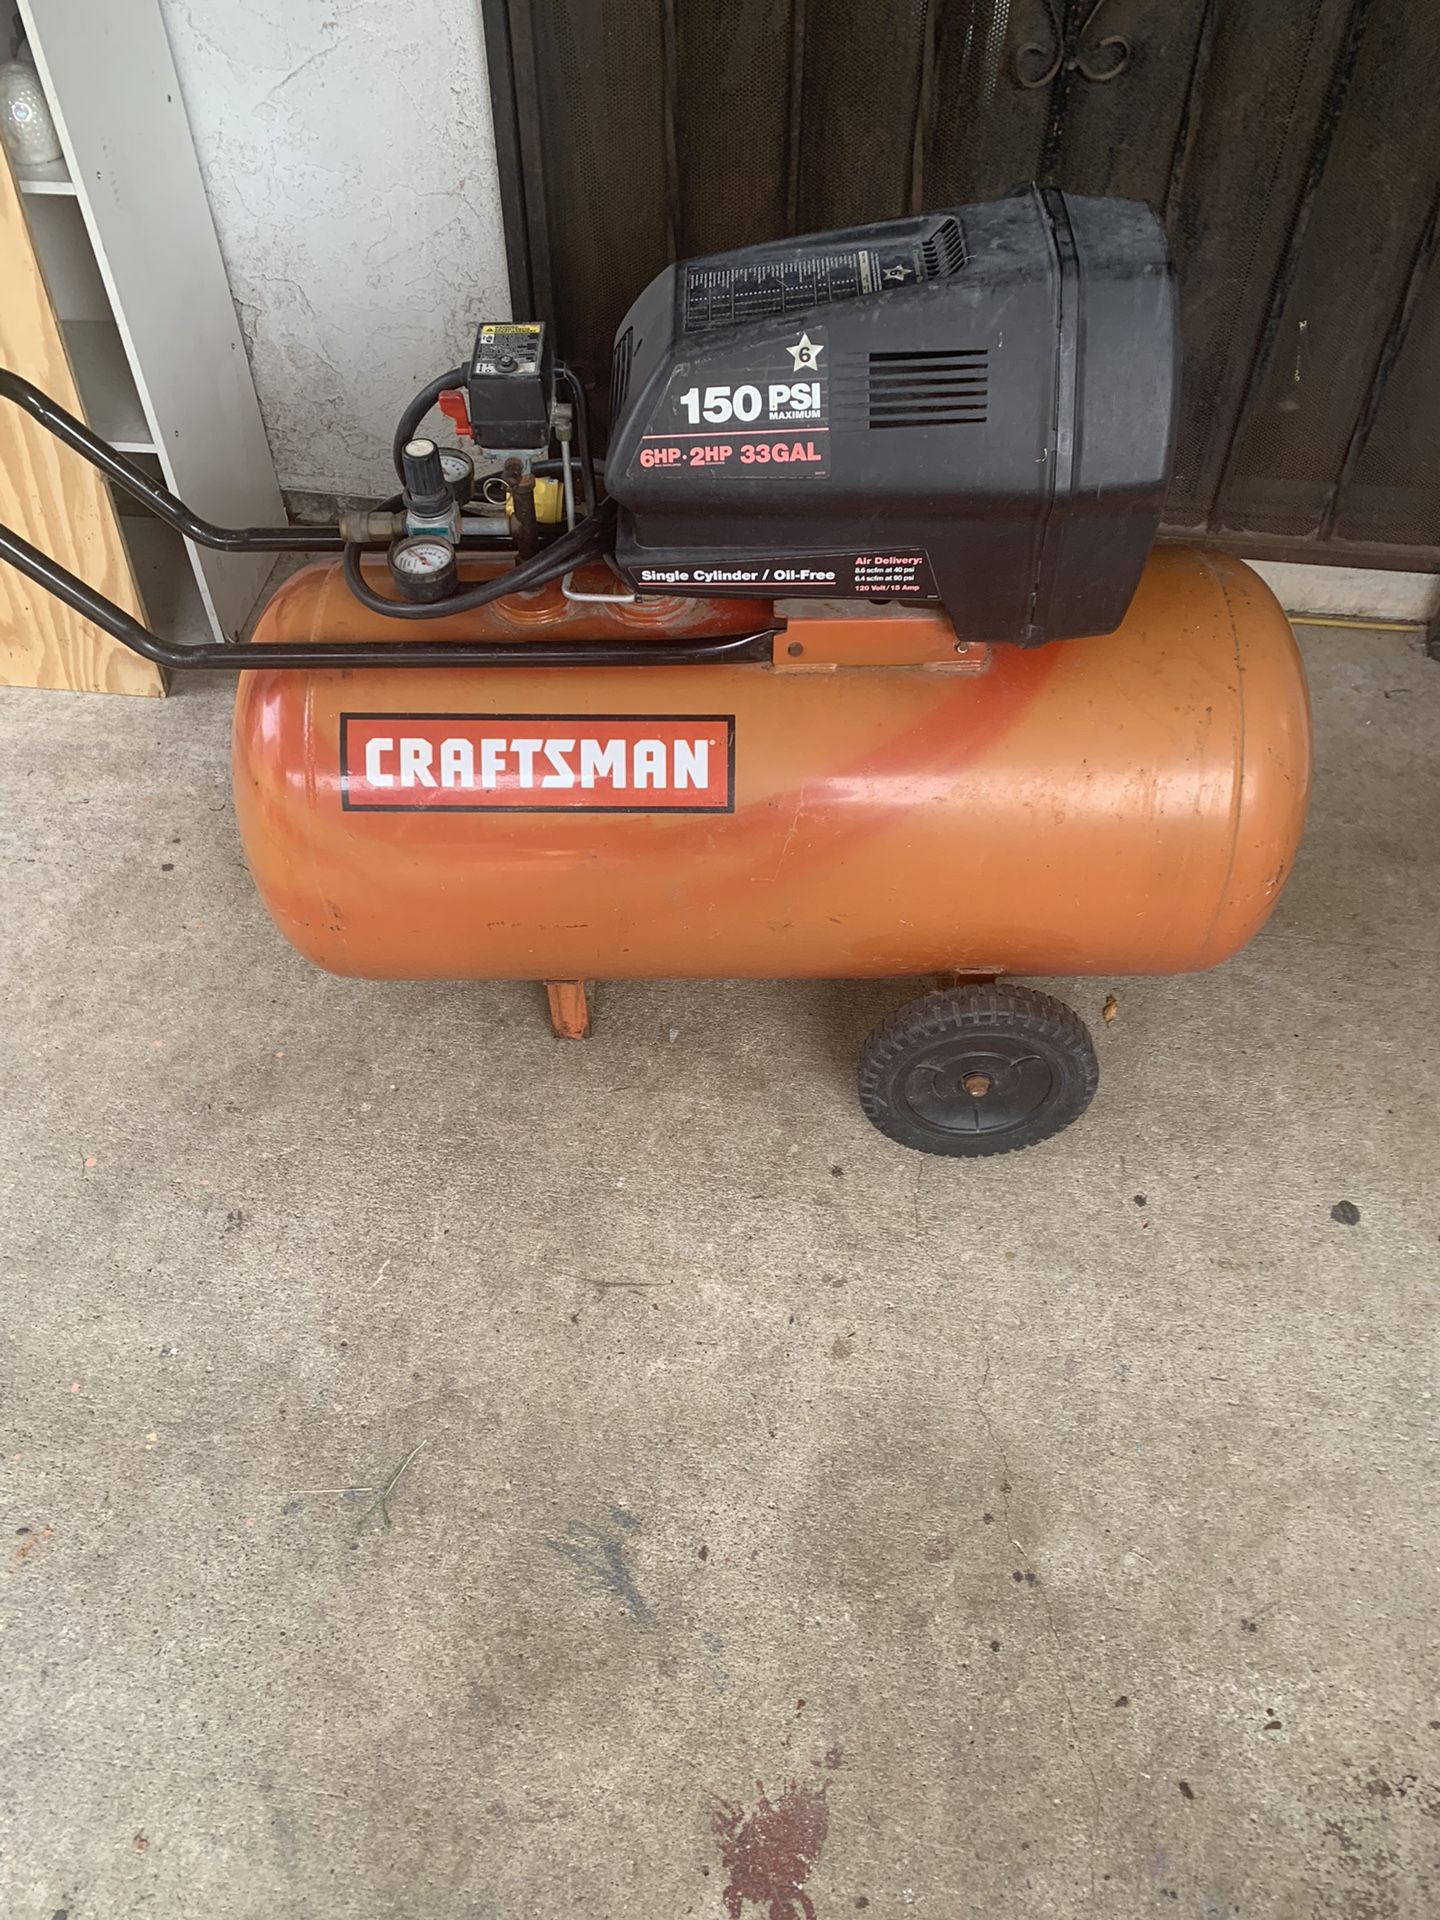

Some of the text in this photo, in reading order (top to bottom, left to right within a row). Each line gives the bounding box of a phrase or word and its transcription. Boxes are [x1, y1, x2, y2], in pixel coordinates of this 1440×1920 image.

[798, 346, 812, 363] 6
[680, 383, 821, 424] 150 PSI
[769, 410, 821, 420] MAXIMUM
[740, 442, 821, 464] 33GAL
[855, 556, 923, 566] Air Delivery:
[641, 569, 836, 583] Single Cylinder / Oil-Free
[903, 566, 915, 574] psi
[903, 574, 915, 582] psi
[901, 584, 920, 592] Amp
[364, 737, 709, 789] CRAFTSMAN
